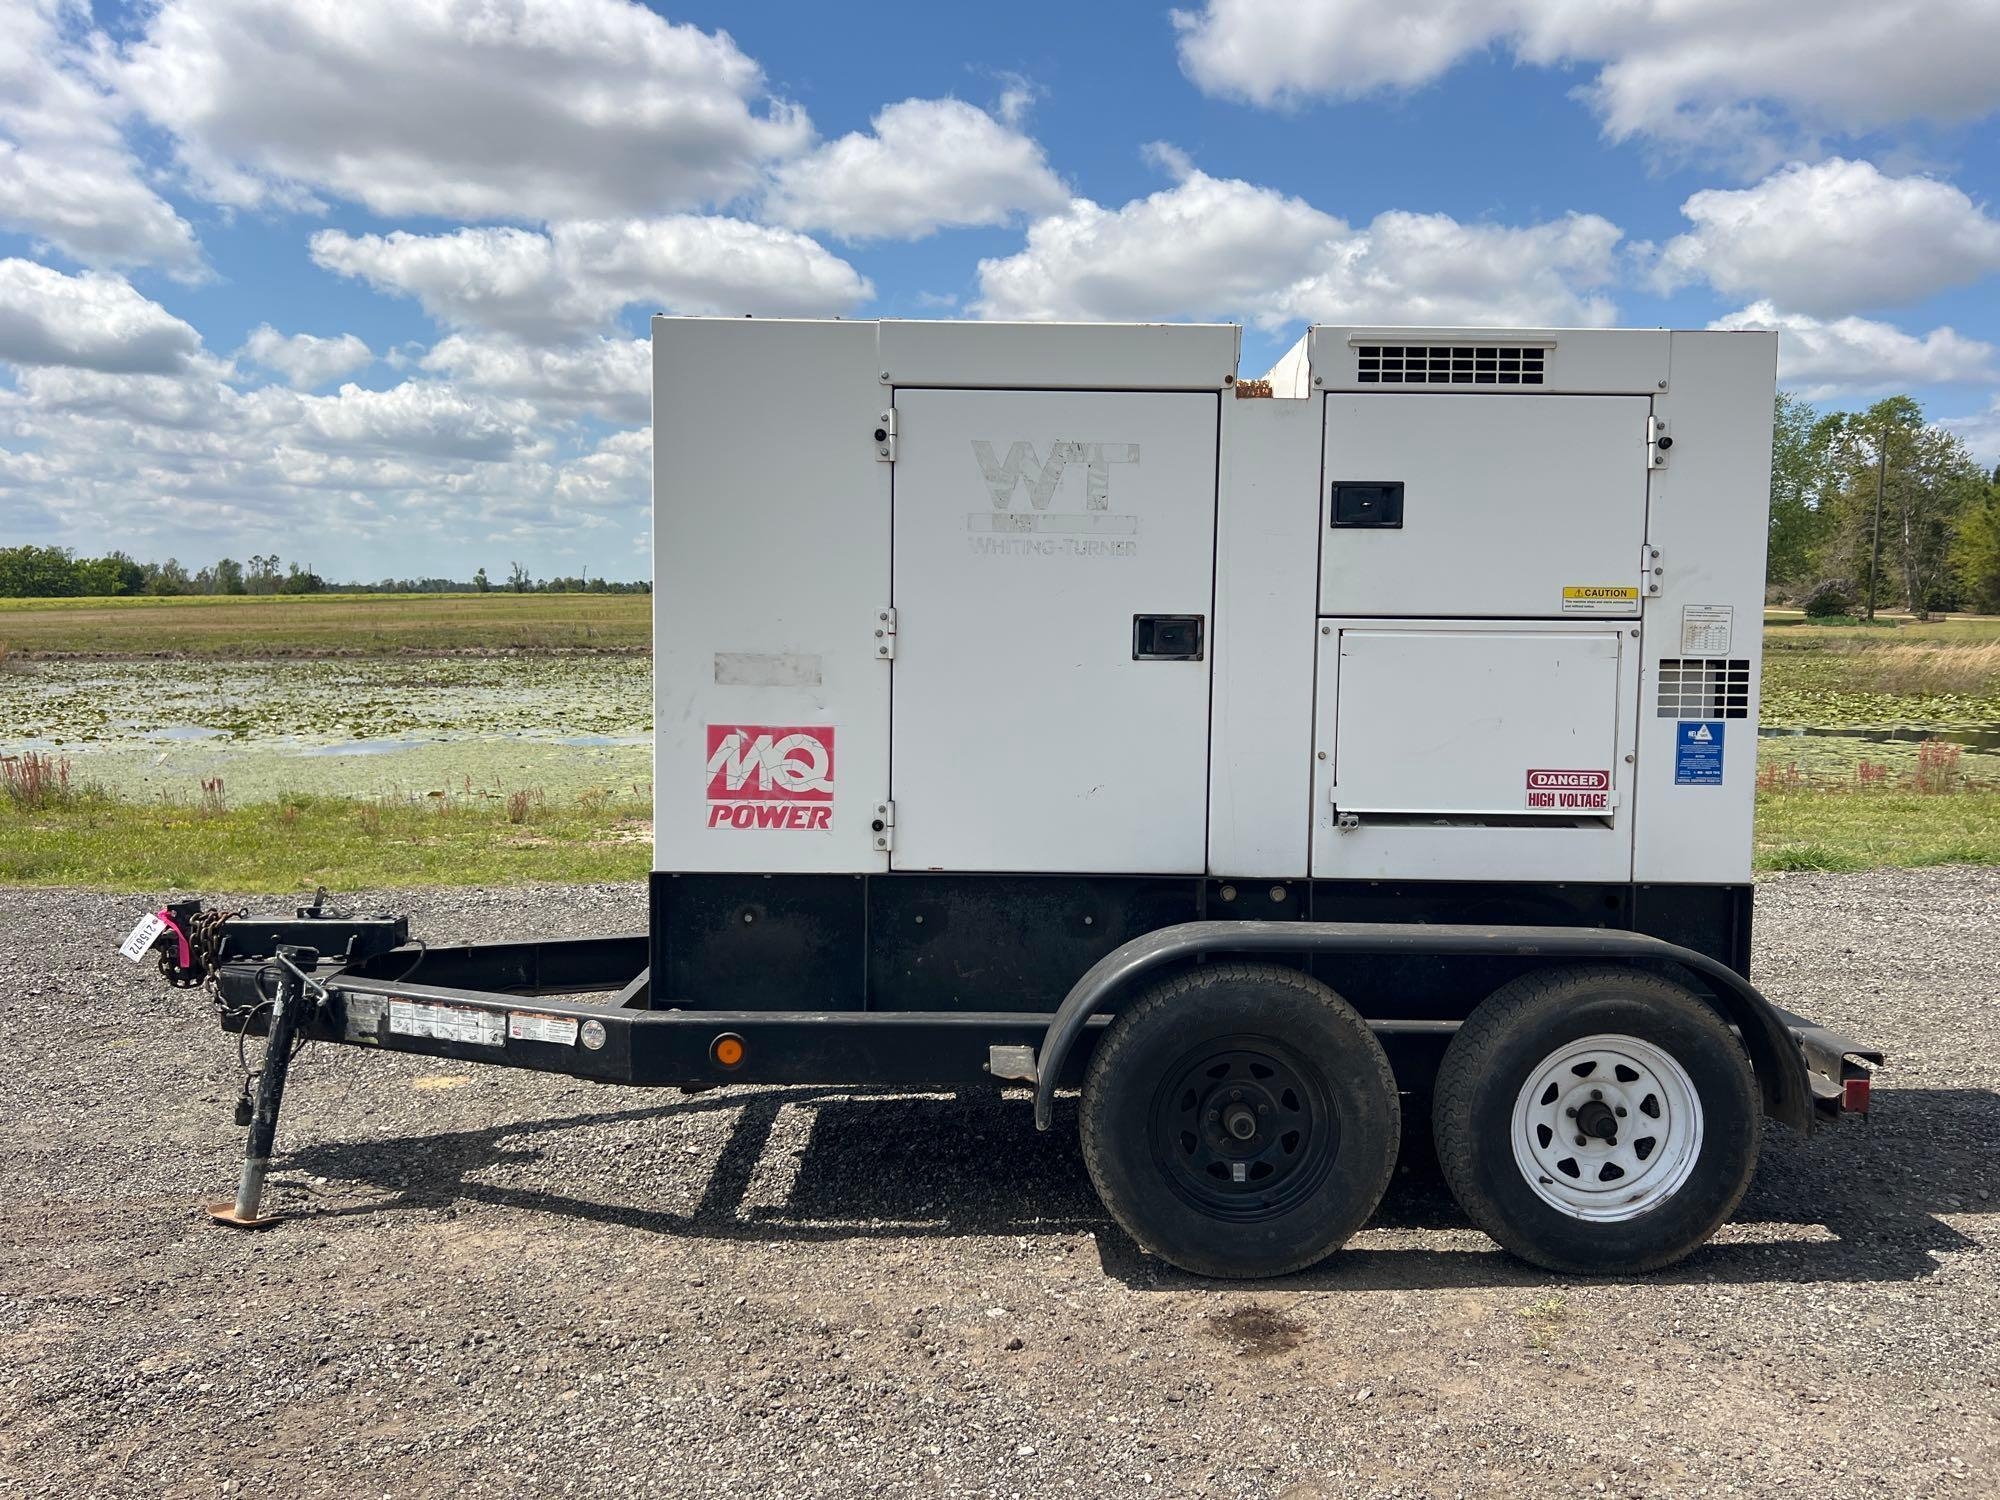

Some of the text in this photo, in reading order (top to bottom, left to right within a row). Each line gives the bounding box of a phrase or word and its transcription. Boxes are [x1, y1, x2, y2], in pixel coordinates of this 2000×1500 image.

[971, 440, 1140, 510] WT
[1584, 589, 1627, 598] CAUTION
[707, 733, 834, 793] MQ
[1537, 775, 1598, 786] DANGER
[1528, 792, 1607, 808] HIGH VOLTAGE
[707, 805, 832, 829] POWER
[129, 924, 157, 955] 215872
